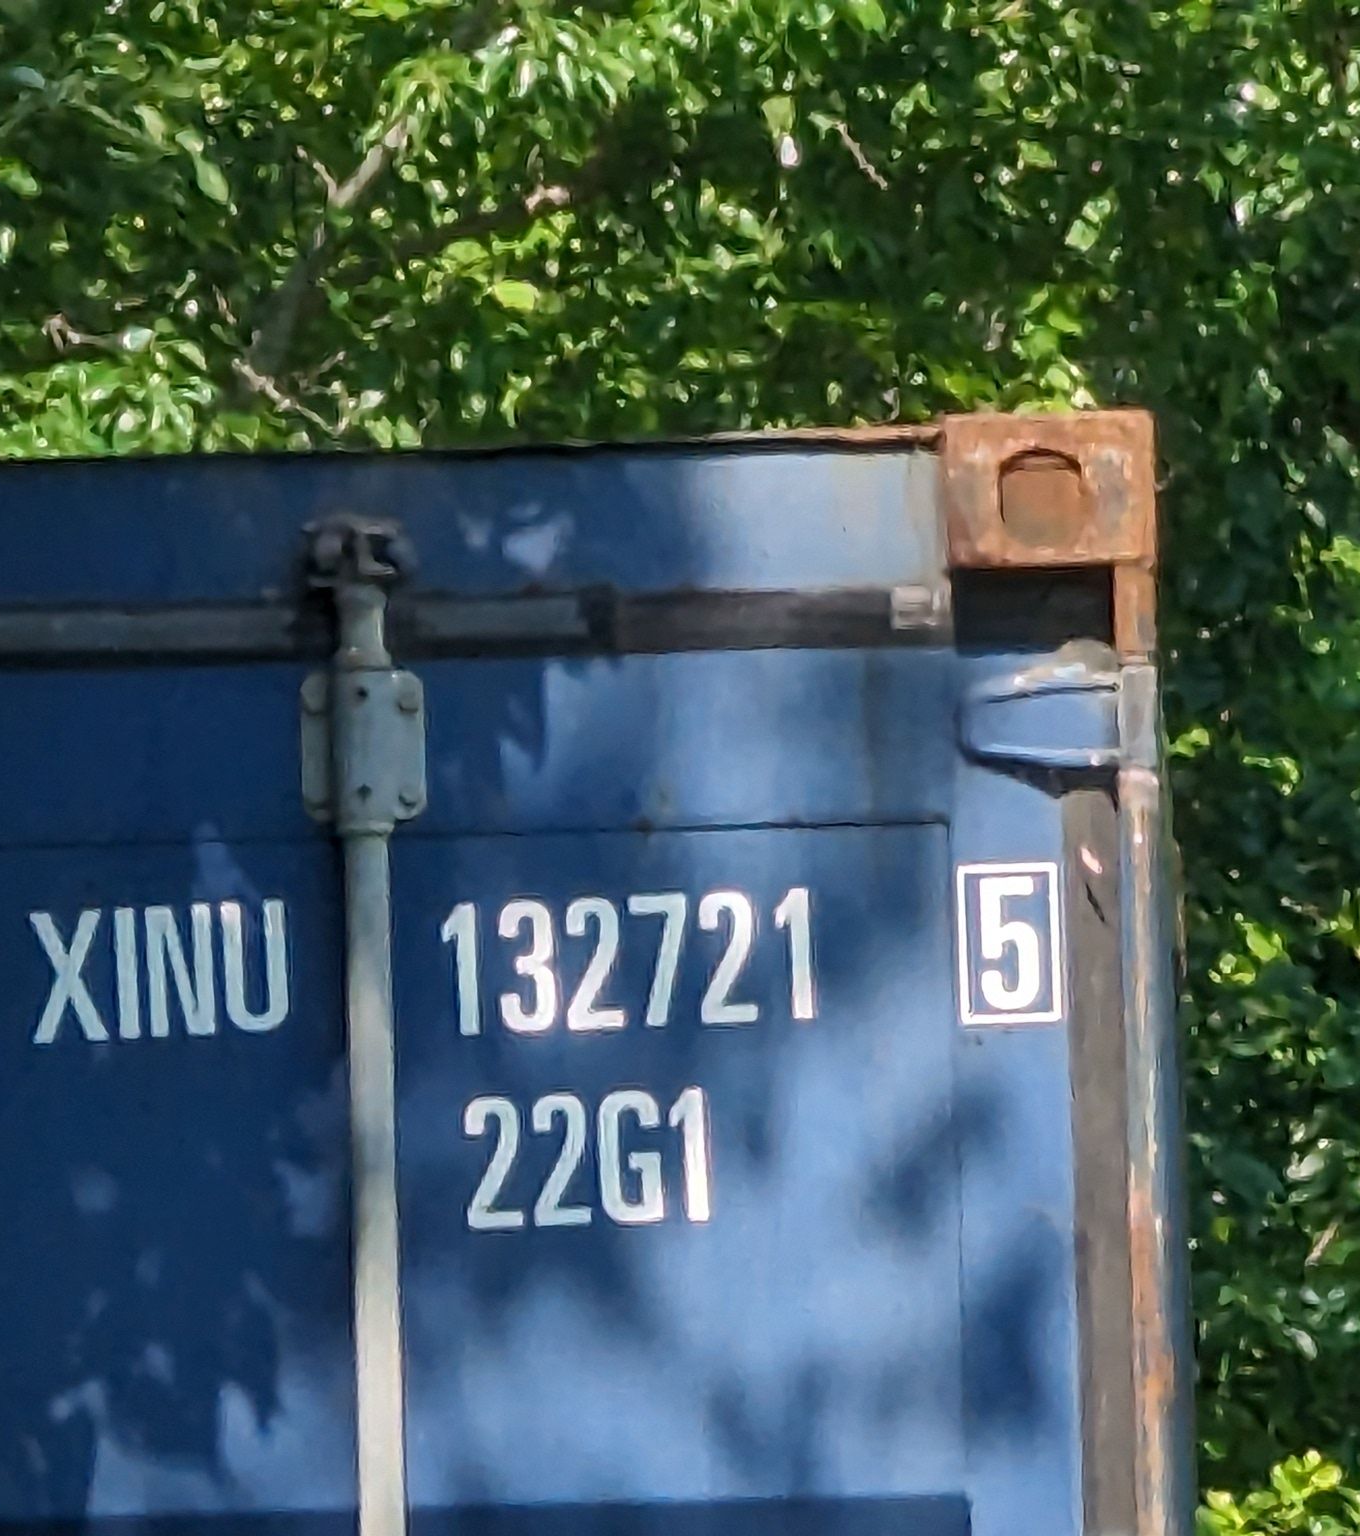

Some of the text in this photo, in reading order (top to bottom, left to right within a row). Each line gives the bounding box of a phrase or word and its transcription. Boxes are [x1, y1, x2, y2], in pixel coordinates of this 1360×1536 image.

[30, 874, 1042, 1044] XINU 132721 5
[463, 1085, 717, 1229] 22G1
